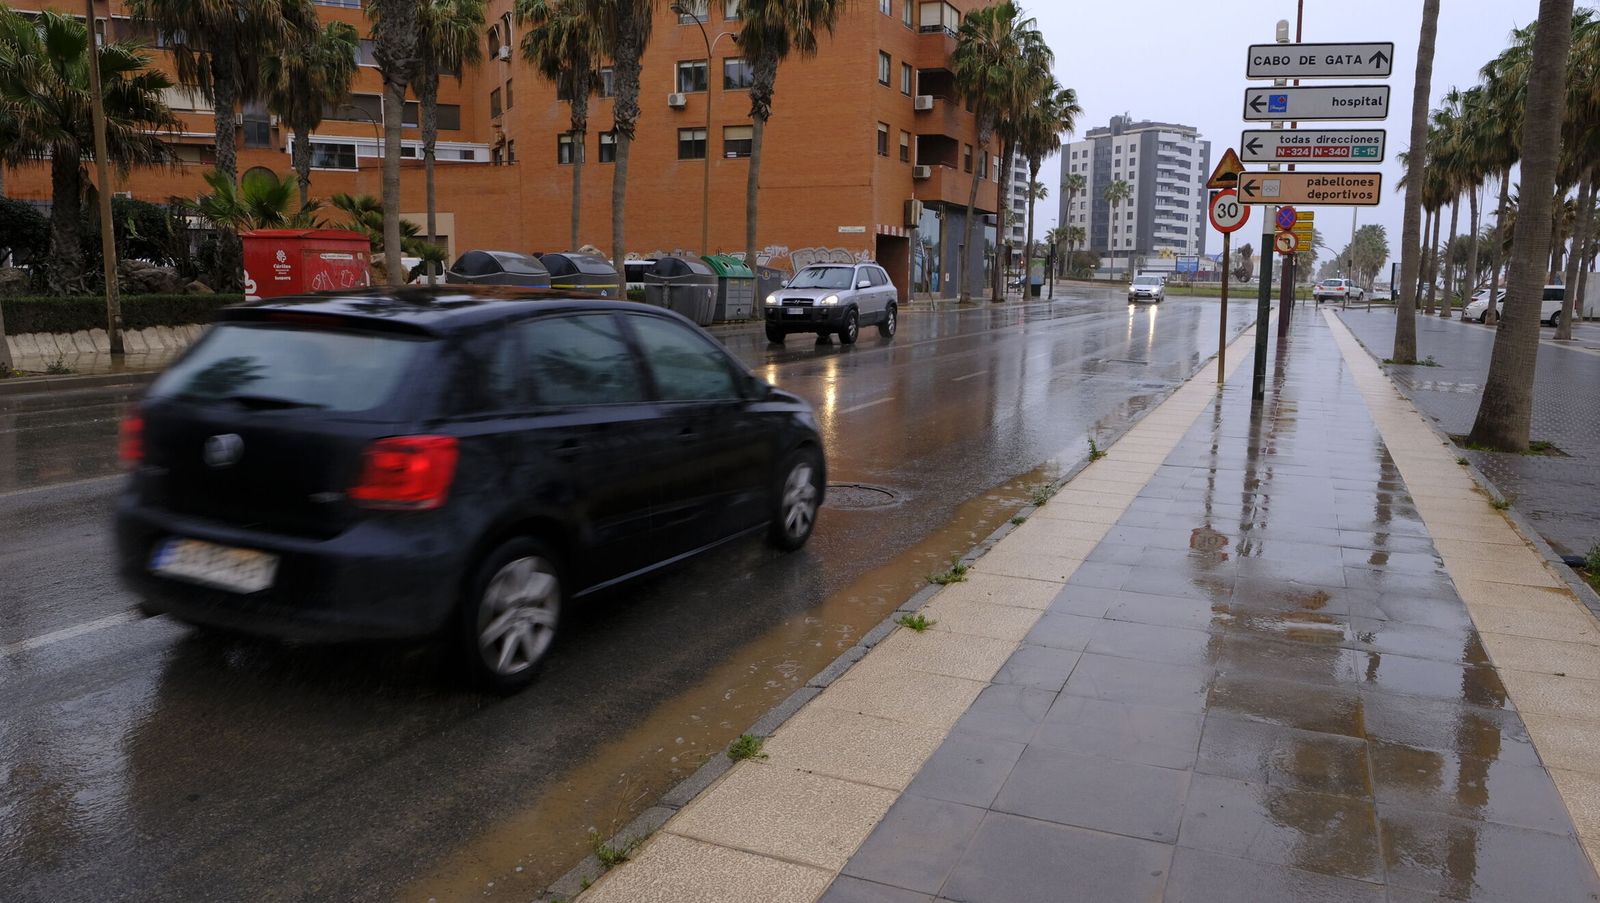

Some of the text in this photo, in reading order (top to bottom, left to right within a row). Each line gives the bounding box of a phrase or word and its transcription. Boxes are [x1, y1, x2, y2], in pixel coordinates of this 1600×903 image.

[1253, 54, 1363, 66] CABO DE GATA
[1332, 96, 1383, 108] hospital
[1280, 135, 1380, 144] todas direcciones
[1307, 177, 1374, 188] pabellones
[1307, 190, 1373, 200] deportivos
[1217, 202, 1239, 219] 30
